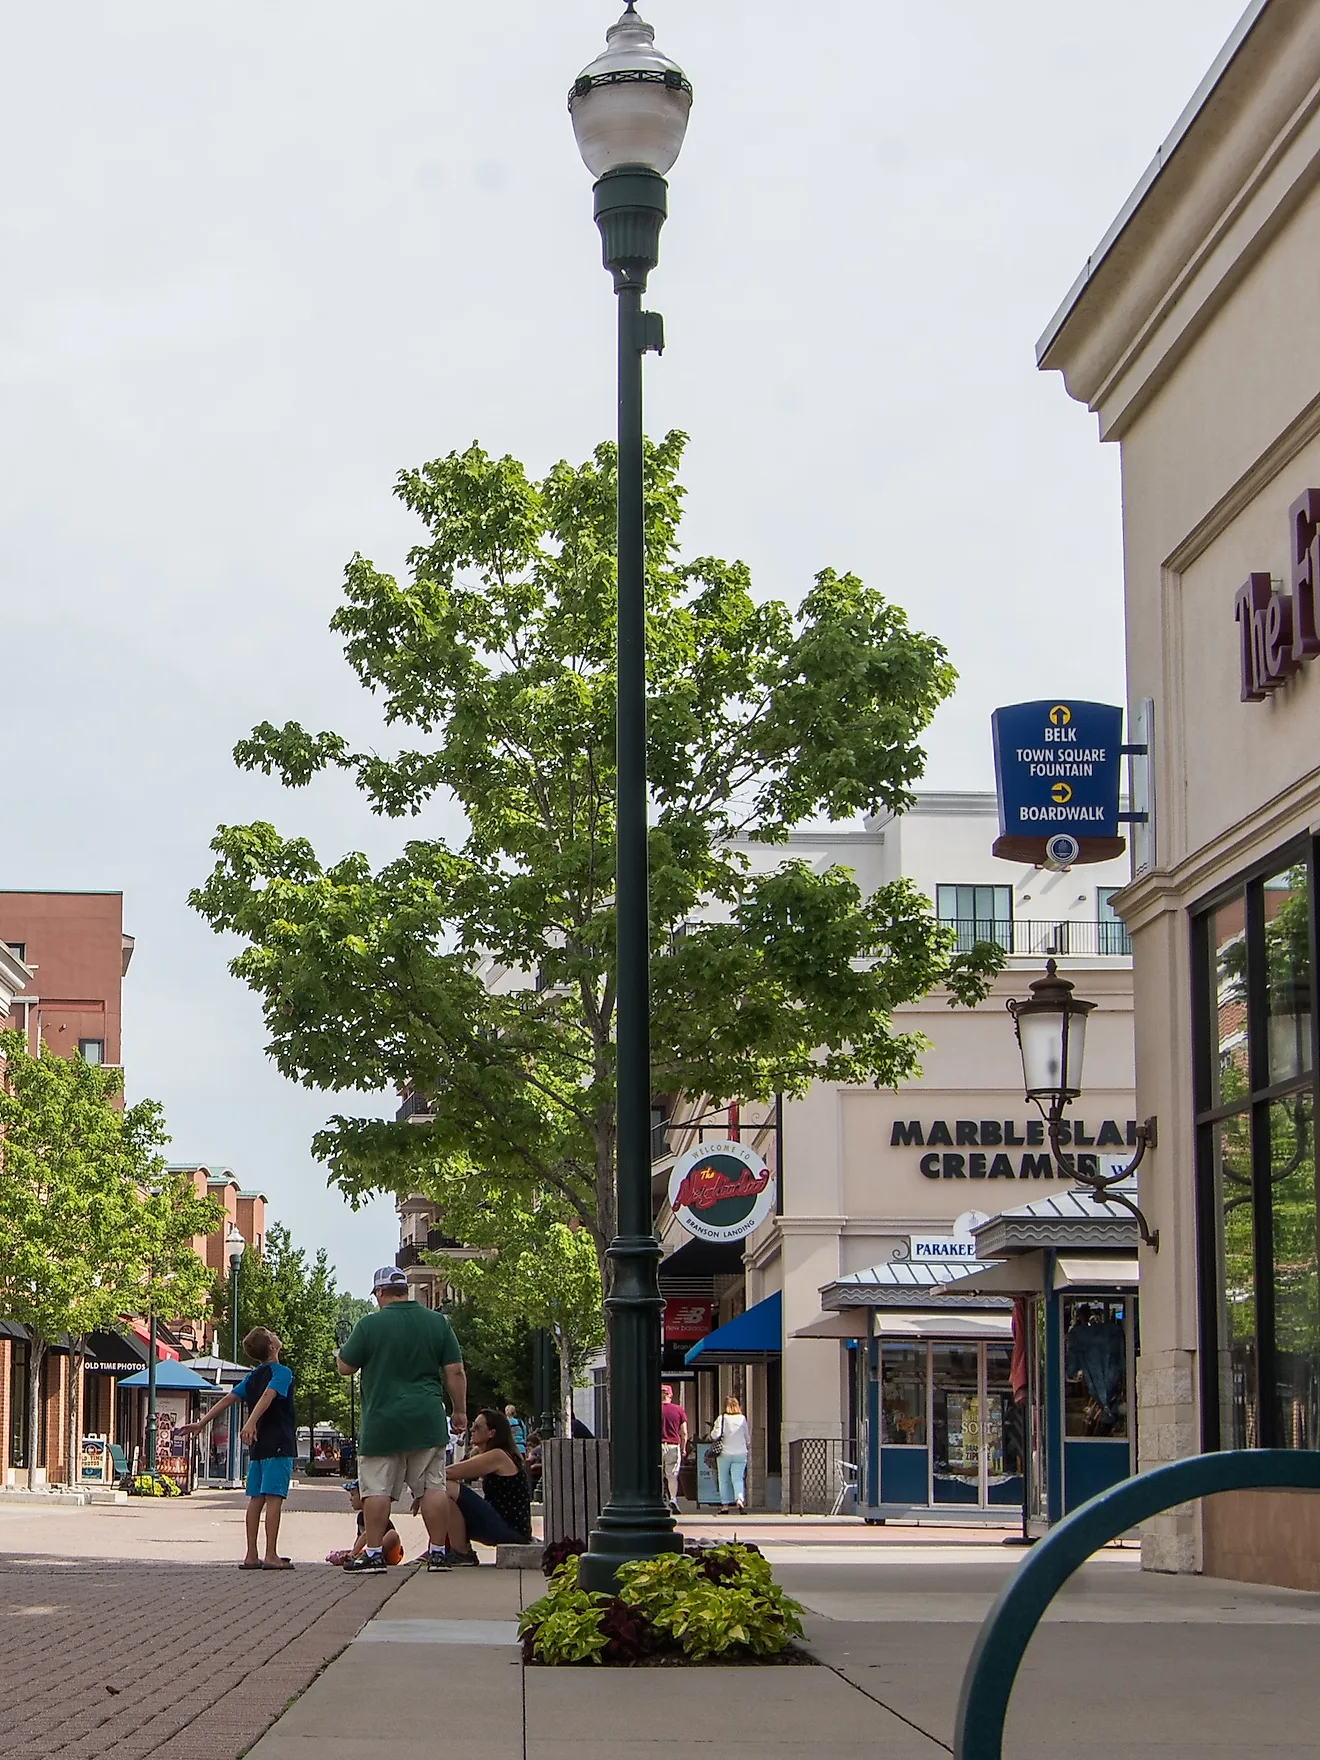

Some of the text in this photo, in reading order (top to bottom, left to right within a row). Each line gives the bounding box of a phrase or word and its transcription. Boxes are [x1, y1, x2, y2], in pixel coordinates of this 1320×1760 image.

[1234, 572, 1292, 703] The
[1044, 727, 1077, 742] BELK
[1016, 749, 1106, 762] TOWN SQUARE
[1030, 763, 1093, 777] FOUNTAIN
[1019, 806, 1105, 821] BOARDWALK
[889, 1120, 1045, 1146] MARBLE
[691, 1144, 751, 1160] WELCOME TO
[700, 1167, 715, 1180] The
[685, 1218, 756, 1238] BRANSON LANDING
[84, 1362, 146, 1371] OLD TIME PHOTOS
